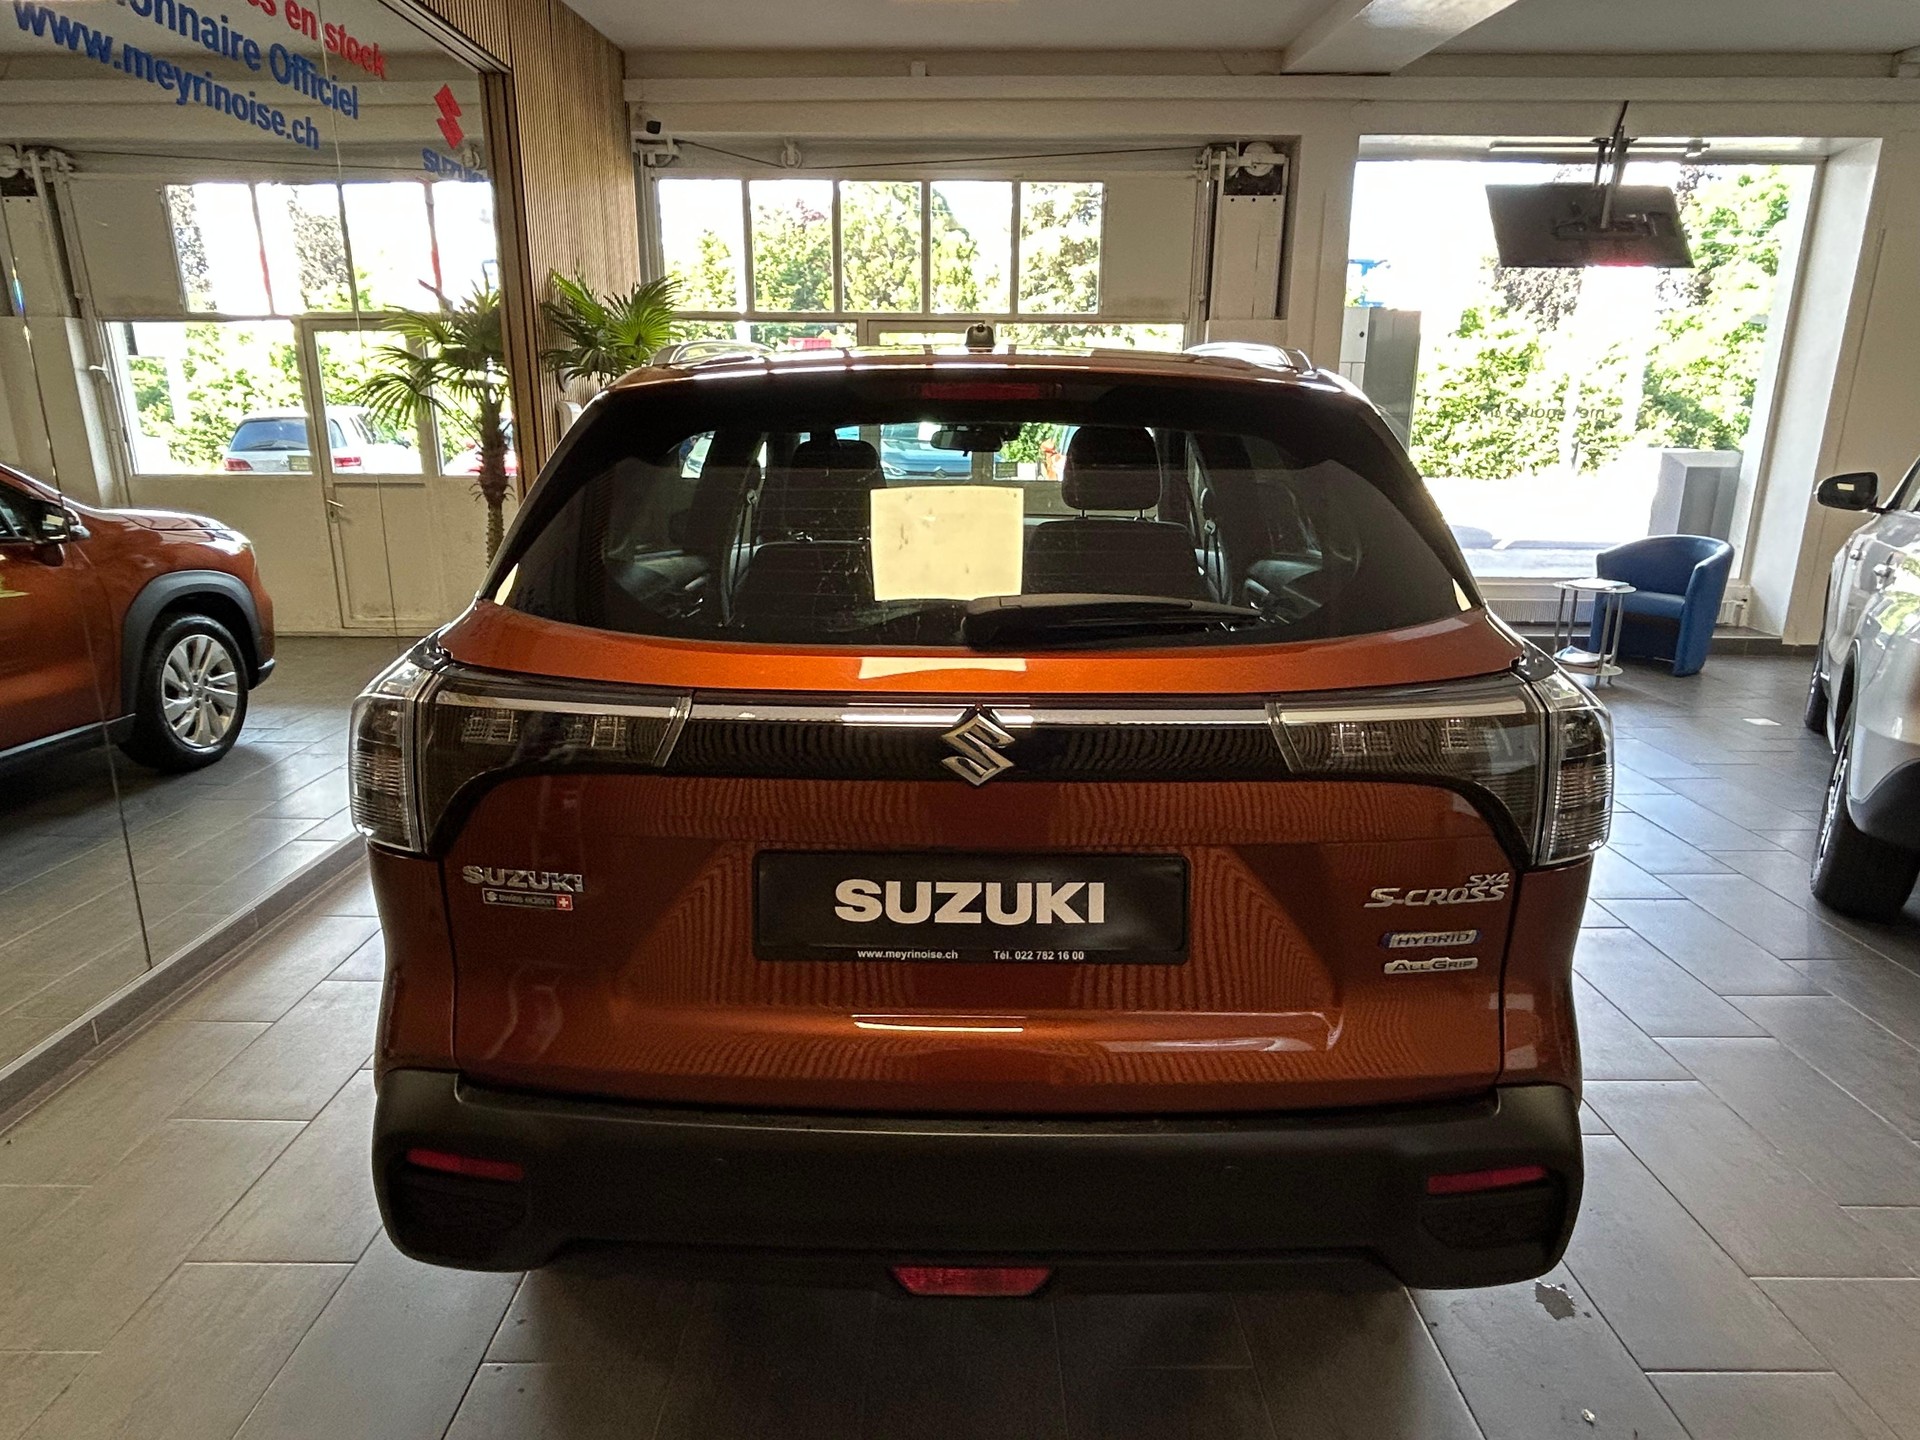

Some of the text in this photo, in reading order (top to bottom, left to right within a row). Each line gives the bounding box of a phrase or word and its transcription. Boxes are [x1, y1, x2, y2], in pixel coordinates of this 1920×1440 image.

[284, 0, 318, 41] en
[323, 22, 387, 81] stock
[13, 0, 320, 151] www.meyrinoise.ch
[269, 43, 359, 120] Officiel
[462, 865, 585, 893] SUZUKI
[1464, 872, 1510, 888] SX4
[834, 879, 1105, 925] SUZUKI
[857, 949, 1085, 961] www.meyrinoise.ch Tél. 022 782 16 00
[1396, 932, 1471, 946] HYBRID
